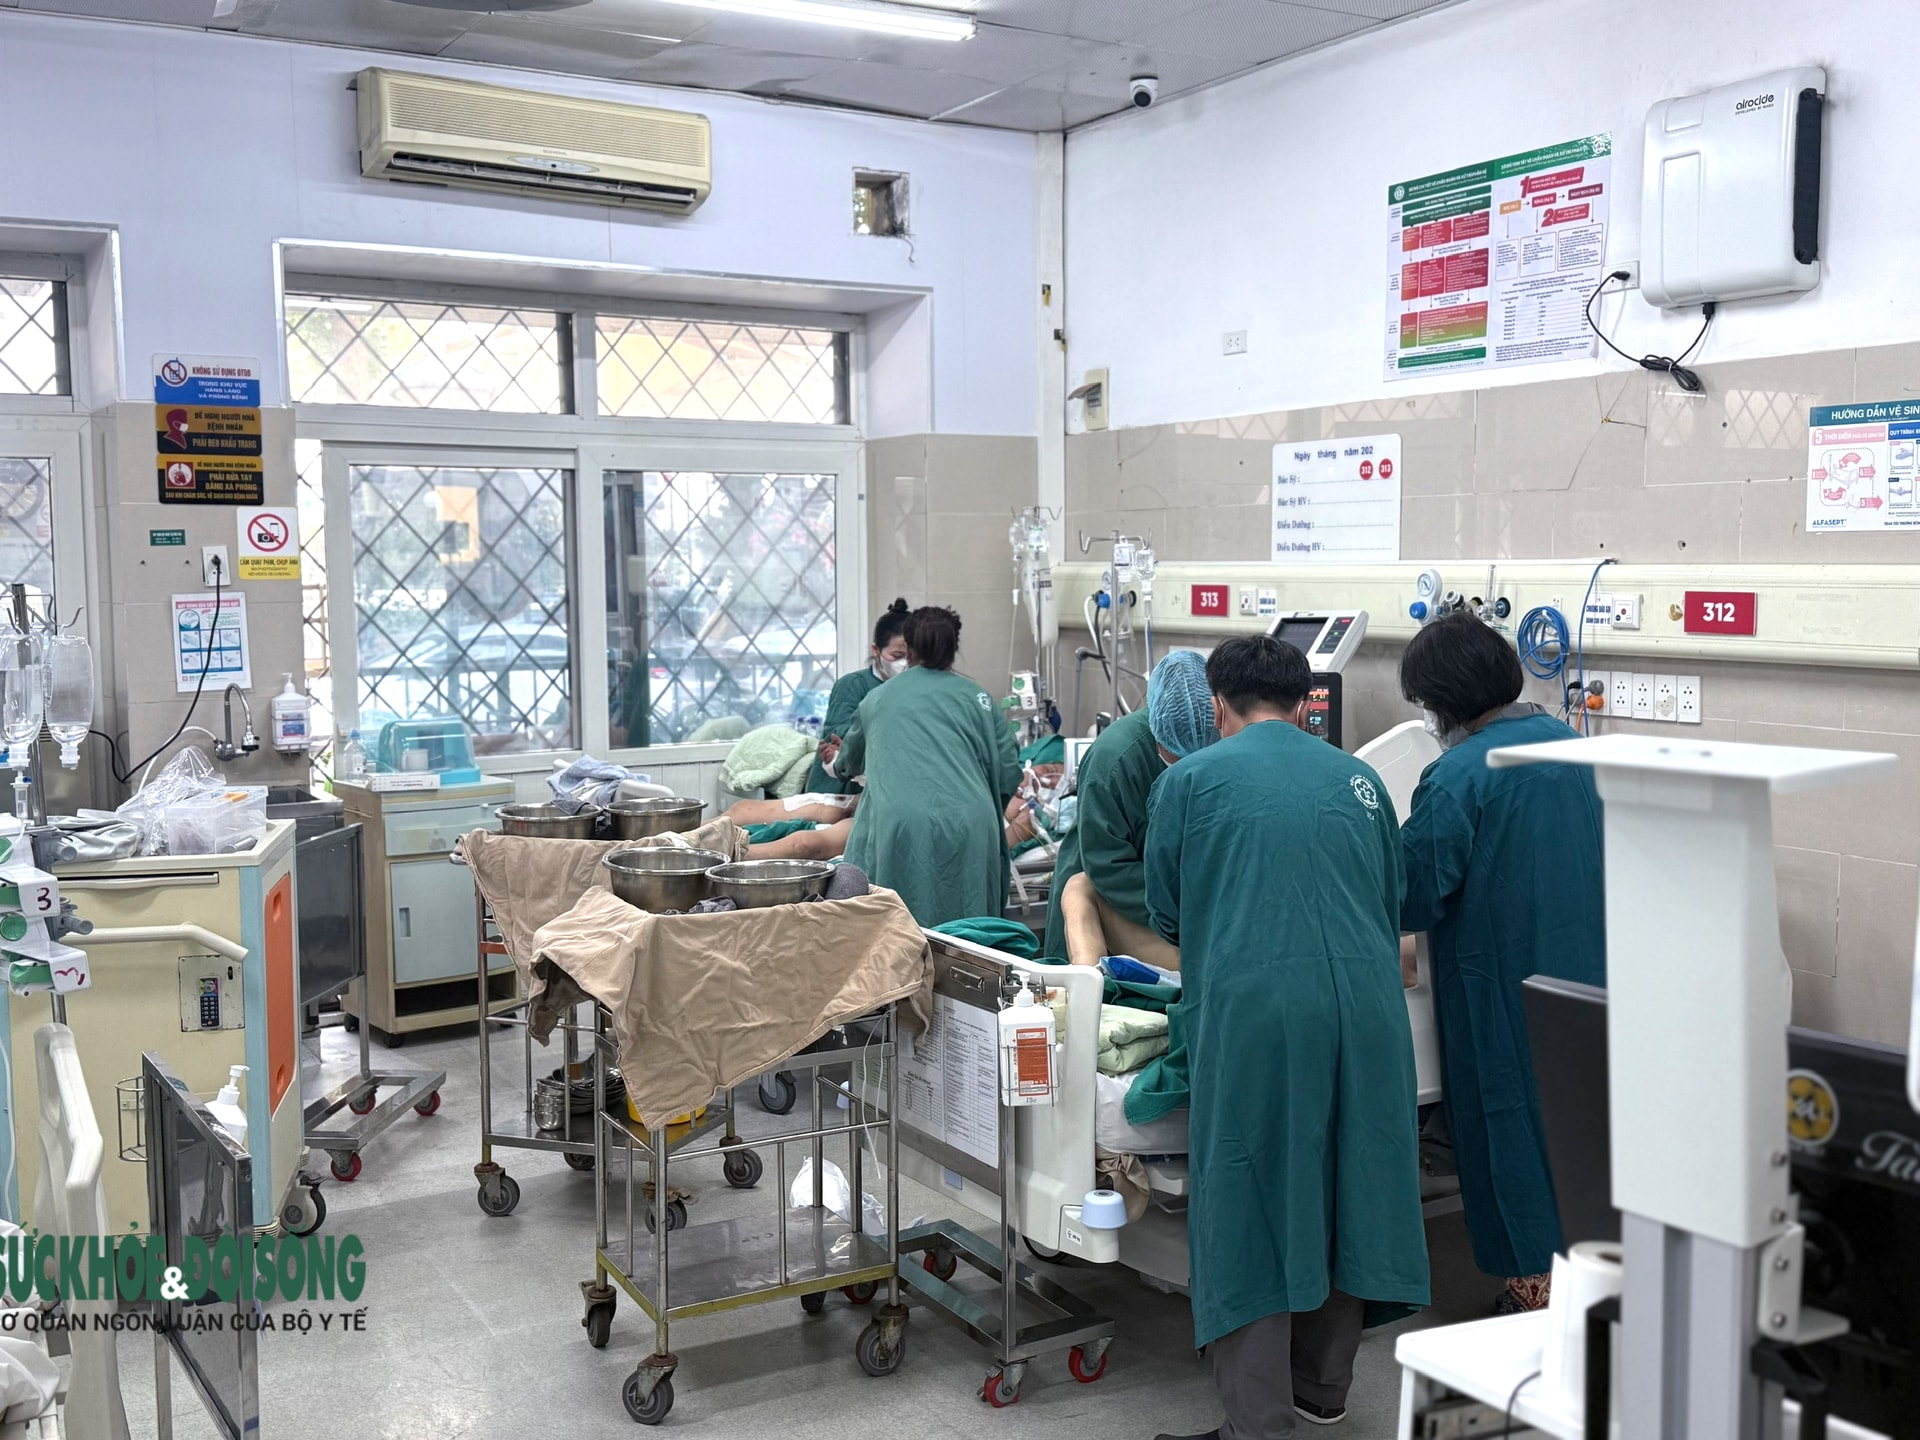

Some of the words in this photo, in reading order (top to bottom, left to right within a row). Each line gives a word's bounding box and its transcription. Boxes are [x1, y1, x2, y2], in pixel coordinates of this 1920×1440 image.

[1831, 408, 1865, 420] HƯỚNG
[1888, 403, 1902, 417] VỆ
[1294, 451, 1311, 462] Ngày
[1317, 449, 1337, 460] tháng
[1344, 447, 1359, 457] năm
[1360, 446, 1374, 455] 202
[1361, 465, 1372, 475] 312
[1380, 463, 1391, 473] 313
[1200, 591, 1219, 608] 313
[1702, 601, 1736, 623] 312
[1027, 696, 1033, 707] 3
[37, 887, 52, 911] 3
[1854, 1130, 1920, 1183] Ta
